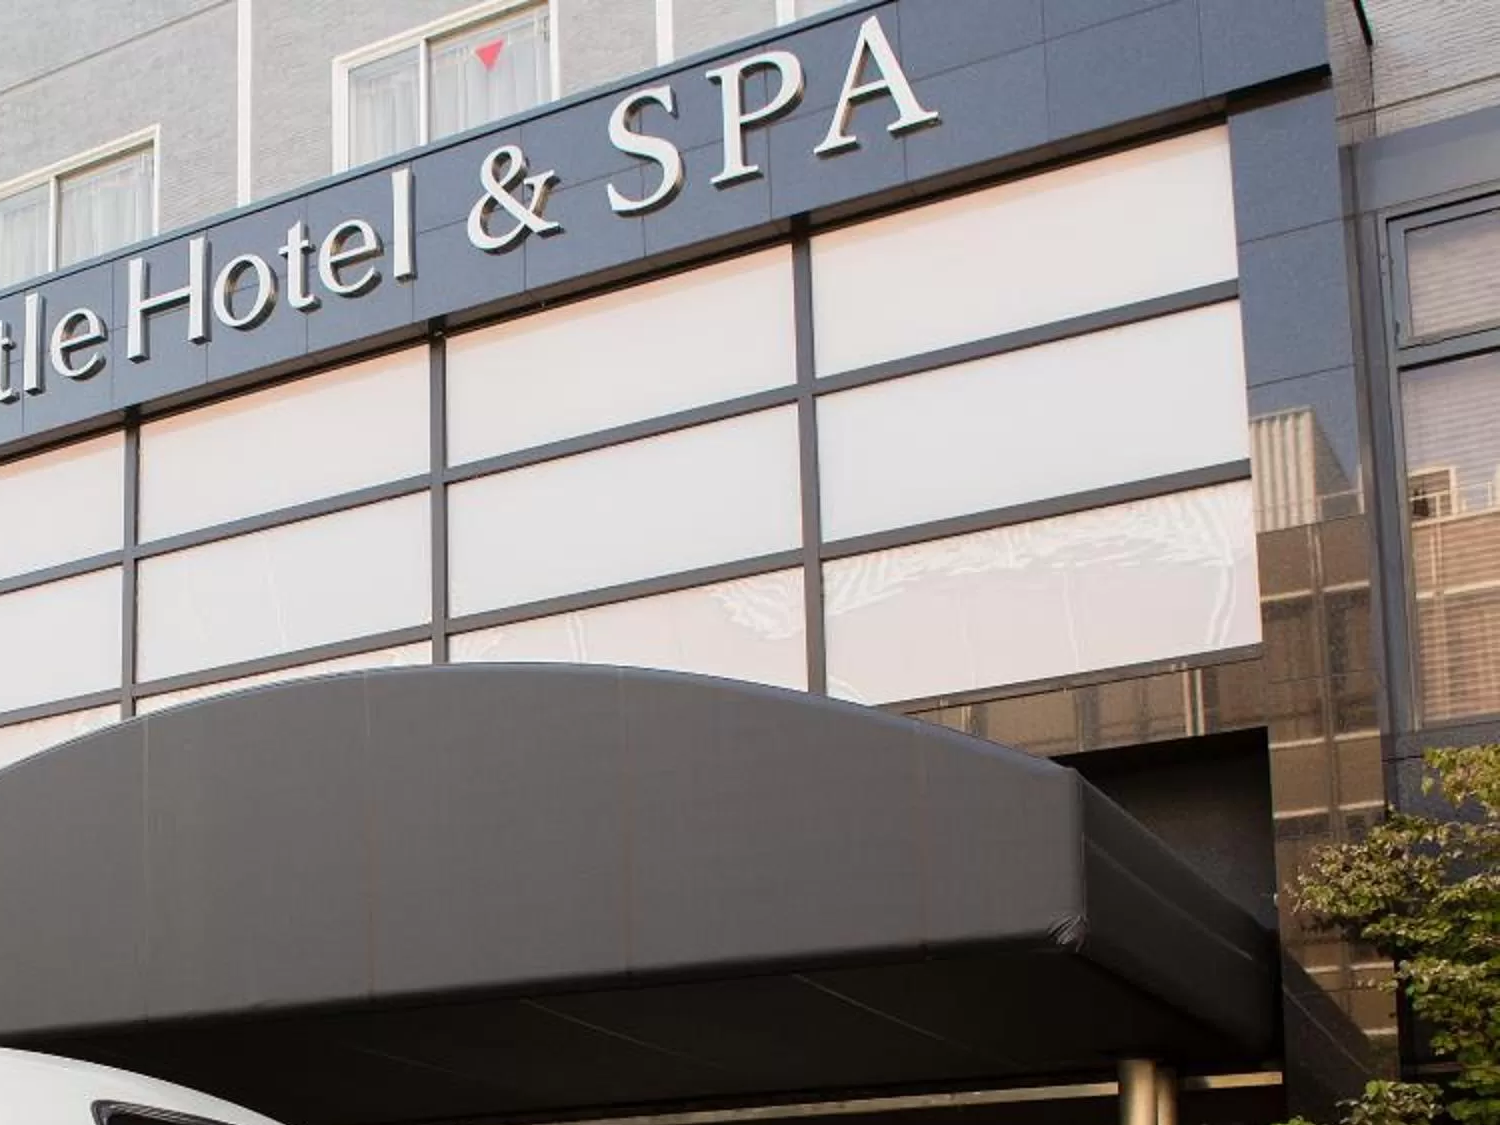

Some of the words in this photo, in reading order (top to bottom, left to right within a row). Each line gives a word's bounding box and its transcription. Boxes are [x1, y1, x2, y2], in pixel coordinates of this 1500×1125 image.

[126, 168, 417, 362] Hotel
[466, 145, 566, 254] &
[606, 15, 940, 216] SPA
